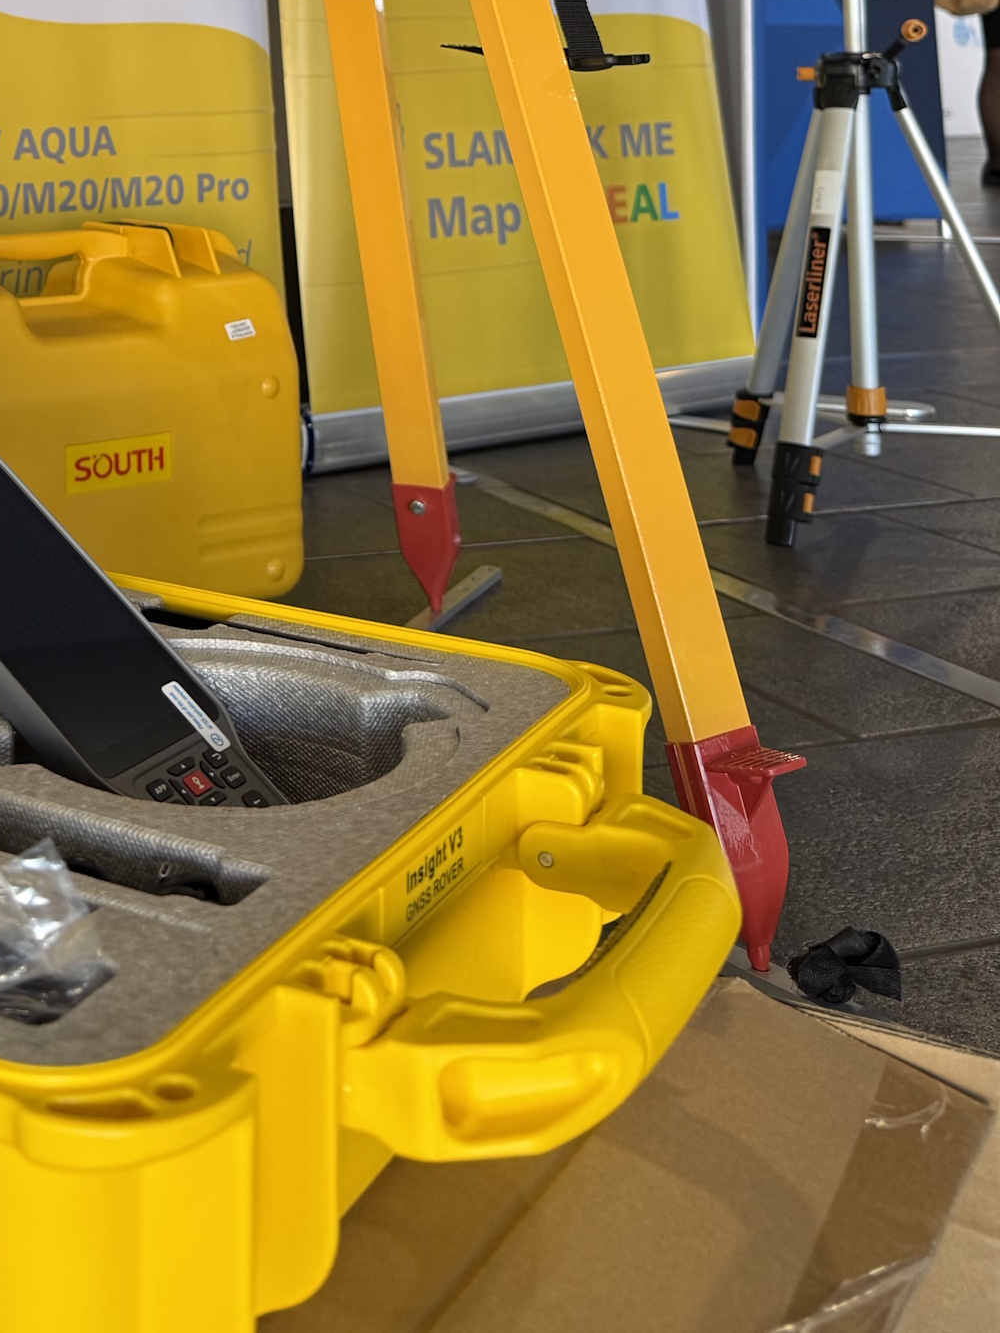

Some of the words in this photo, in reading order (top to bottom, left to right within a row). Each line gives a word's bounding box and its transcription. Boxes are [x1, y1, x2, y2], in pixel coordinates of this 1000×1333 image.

[13, 125, 118, 164] AQUA
[619, 121, 675, 159] ME
[197, 172, 250, 203] Pro
[427, 195, 522, 245] Map
[606, 181, 680, 225] EAL
[799, 240, 828, 334] Laserliner
[74, 446, 164, 482] SOUTH
[154, 783, 167, 795] APP
[227, 771, 241, 782] Enter
[406, 840, 447, 895] Insight
[449, 826, 463, 855] V3
[406, 886, 432, 921] GNSS
[433, 856, 464, 897] ROVER
